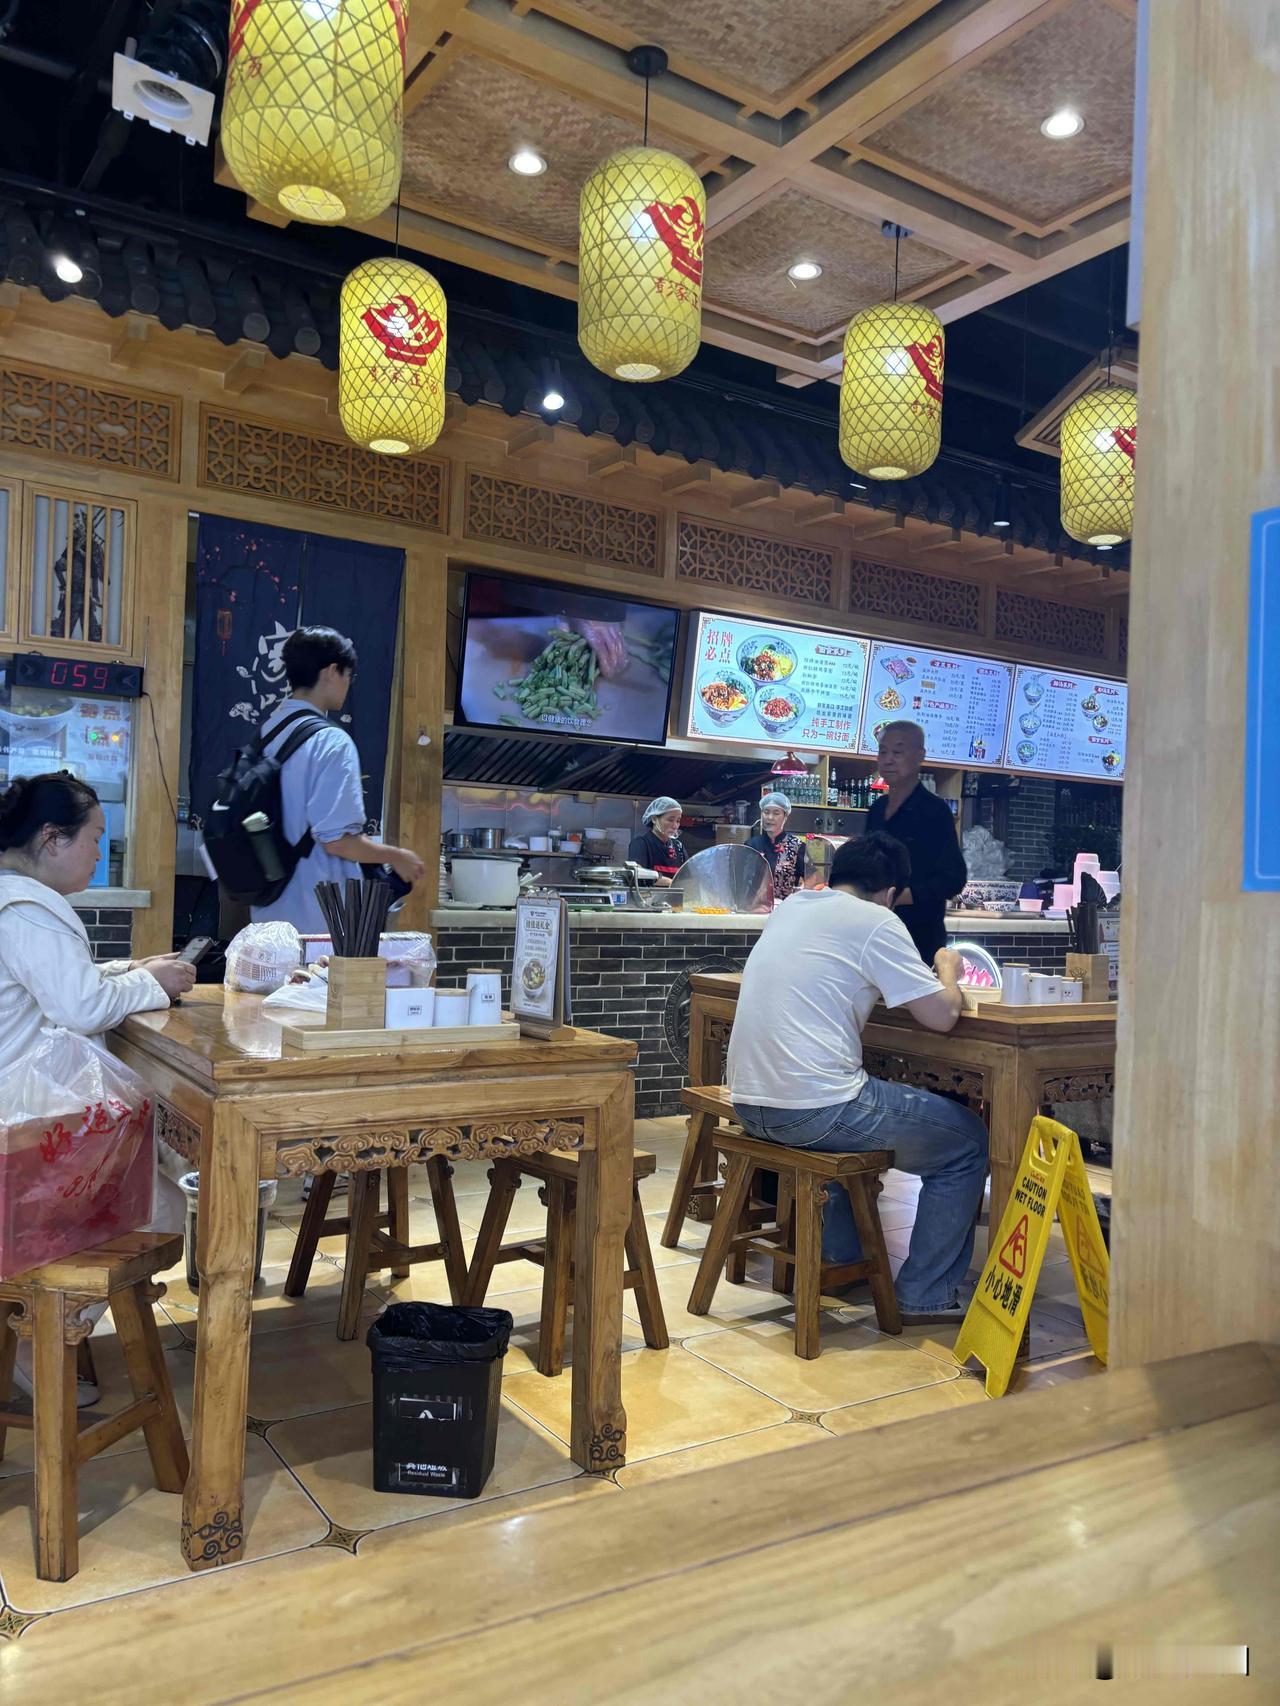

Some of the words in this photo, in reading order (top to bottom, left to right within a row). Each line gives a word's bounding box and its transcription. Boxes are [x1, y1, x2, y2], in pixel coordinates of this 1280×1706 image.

[707, 629, 734, 647] 招牌
[705, 646, 731, 664] 必点
[50, 661, 109, 690] 059
[802, 728, 850, 742] 只为一碗好面
[811, 717, 852, 731] 纯手工制作
[1022, 1175, 1048, 1201] CAUTION
[1015, 1188, 1027, 1206] WET
[1027, 1196, 1046, 1218] FLOOR
[985, 1265, 1023, 1317] 小心地滑
